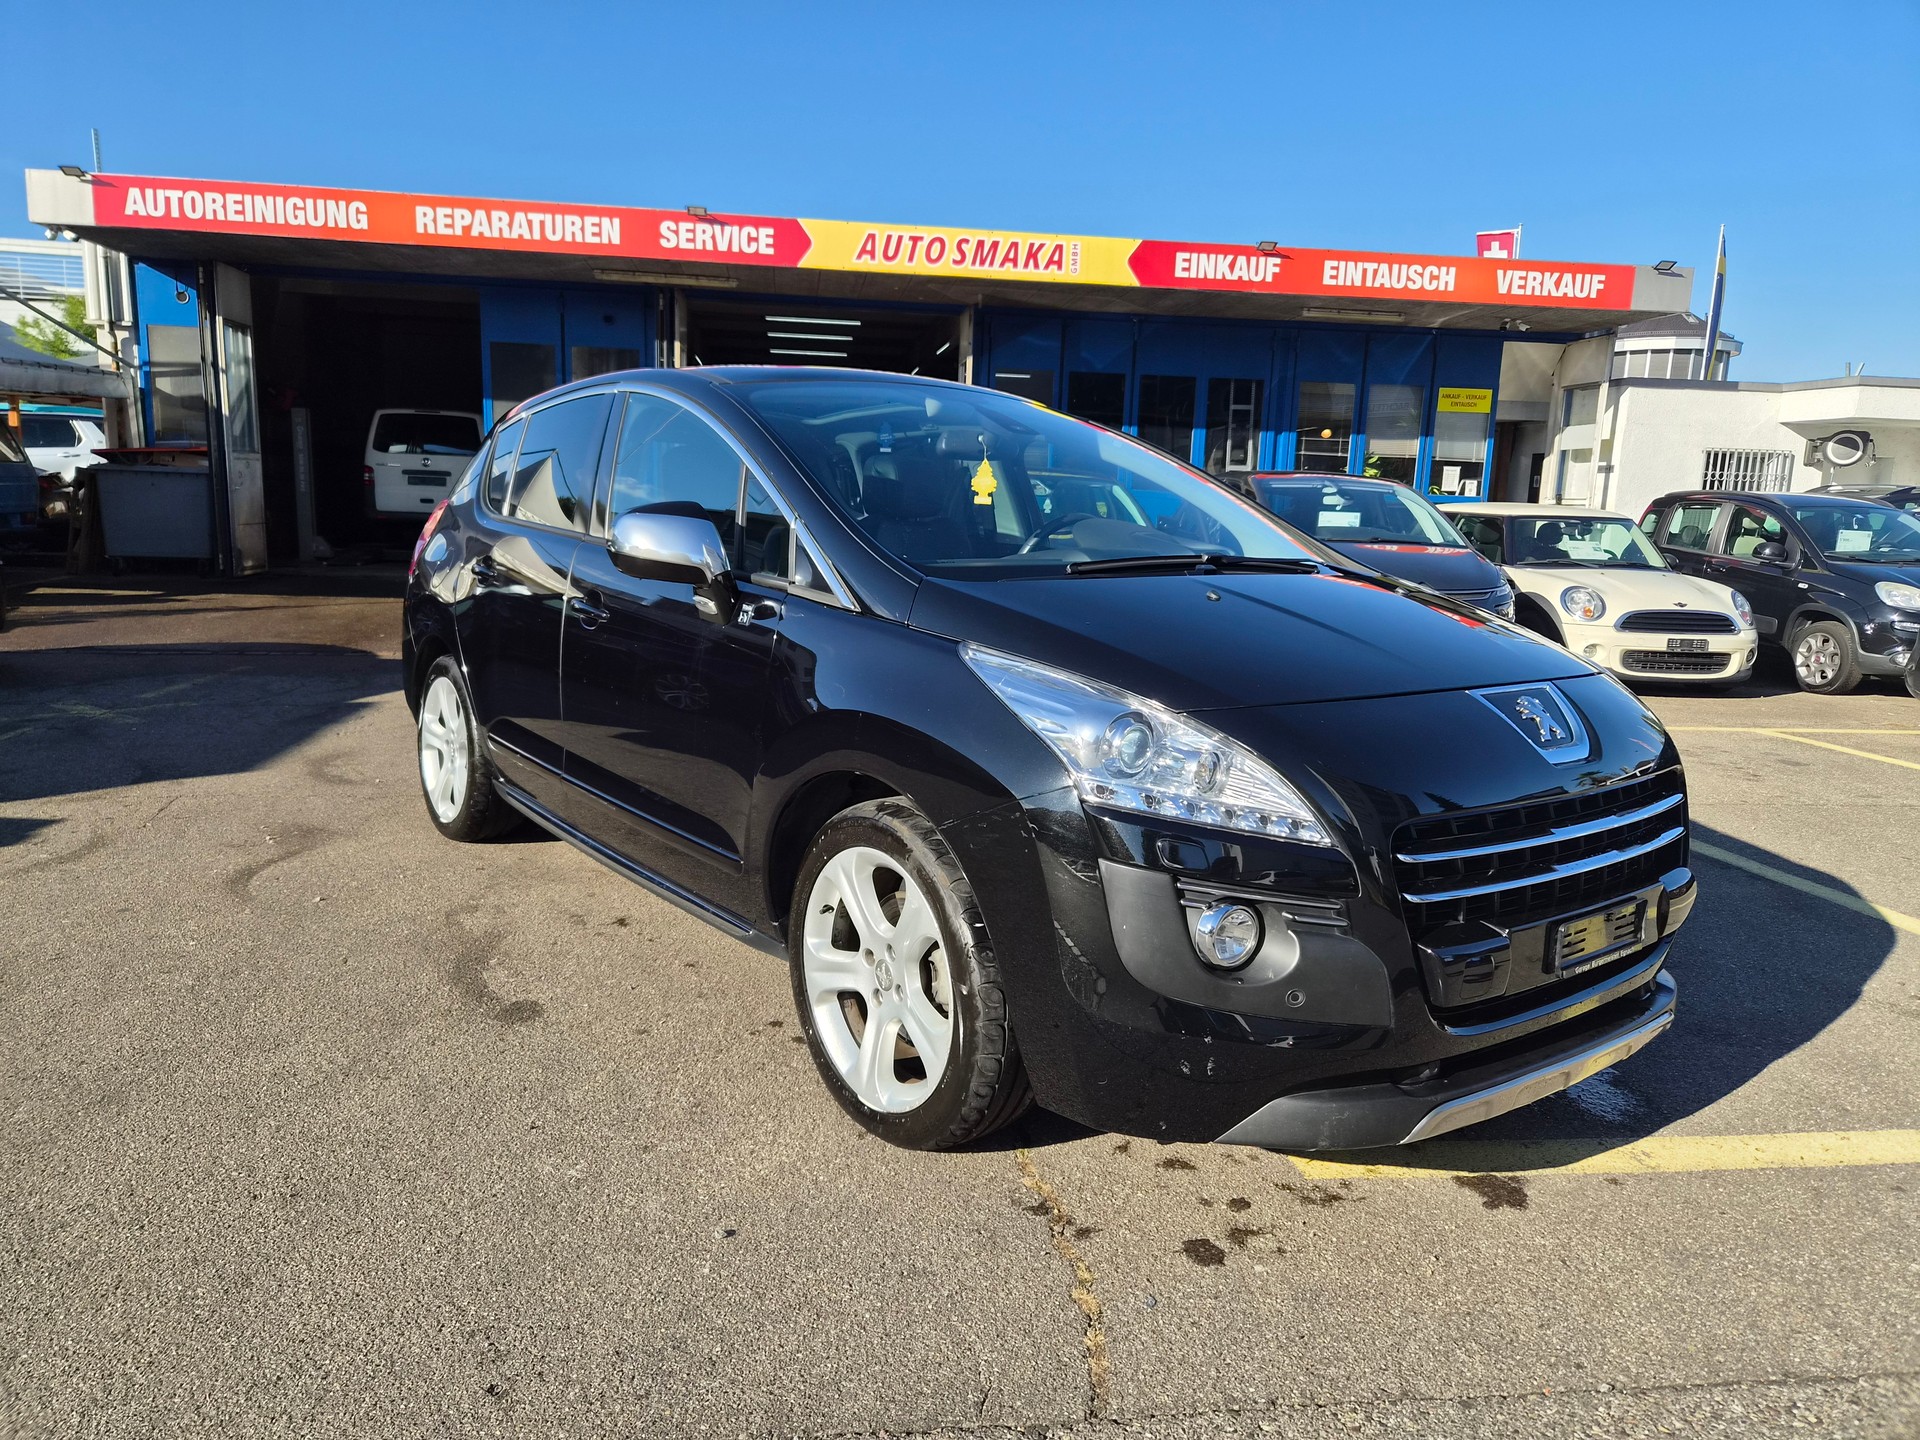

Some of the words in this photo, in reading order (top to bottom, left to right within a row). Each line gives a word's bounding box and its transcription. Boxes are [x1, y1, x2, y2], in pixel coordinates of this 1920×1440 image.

[125, 187, 368, 230] AUTOREINIGUNG
[415, 205, 621, 245] REPARATUREN
[659, 220, 775, 255] SERVICE
[855, 233, 947, 265] AUTO
[951, 238, 1064, 271] SMAKA
[1070, 243, 1079, 274] GMBH
[1174, 251, 1282, 283] EINKAUF
[1322, 259, 1456, 292] EINTAUSCH
[1496, 269, 1606, 299] VERKAUF
